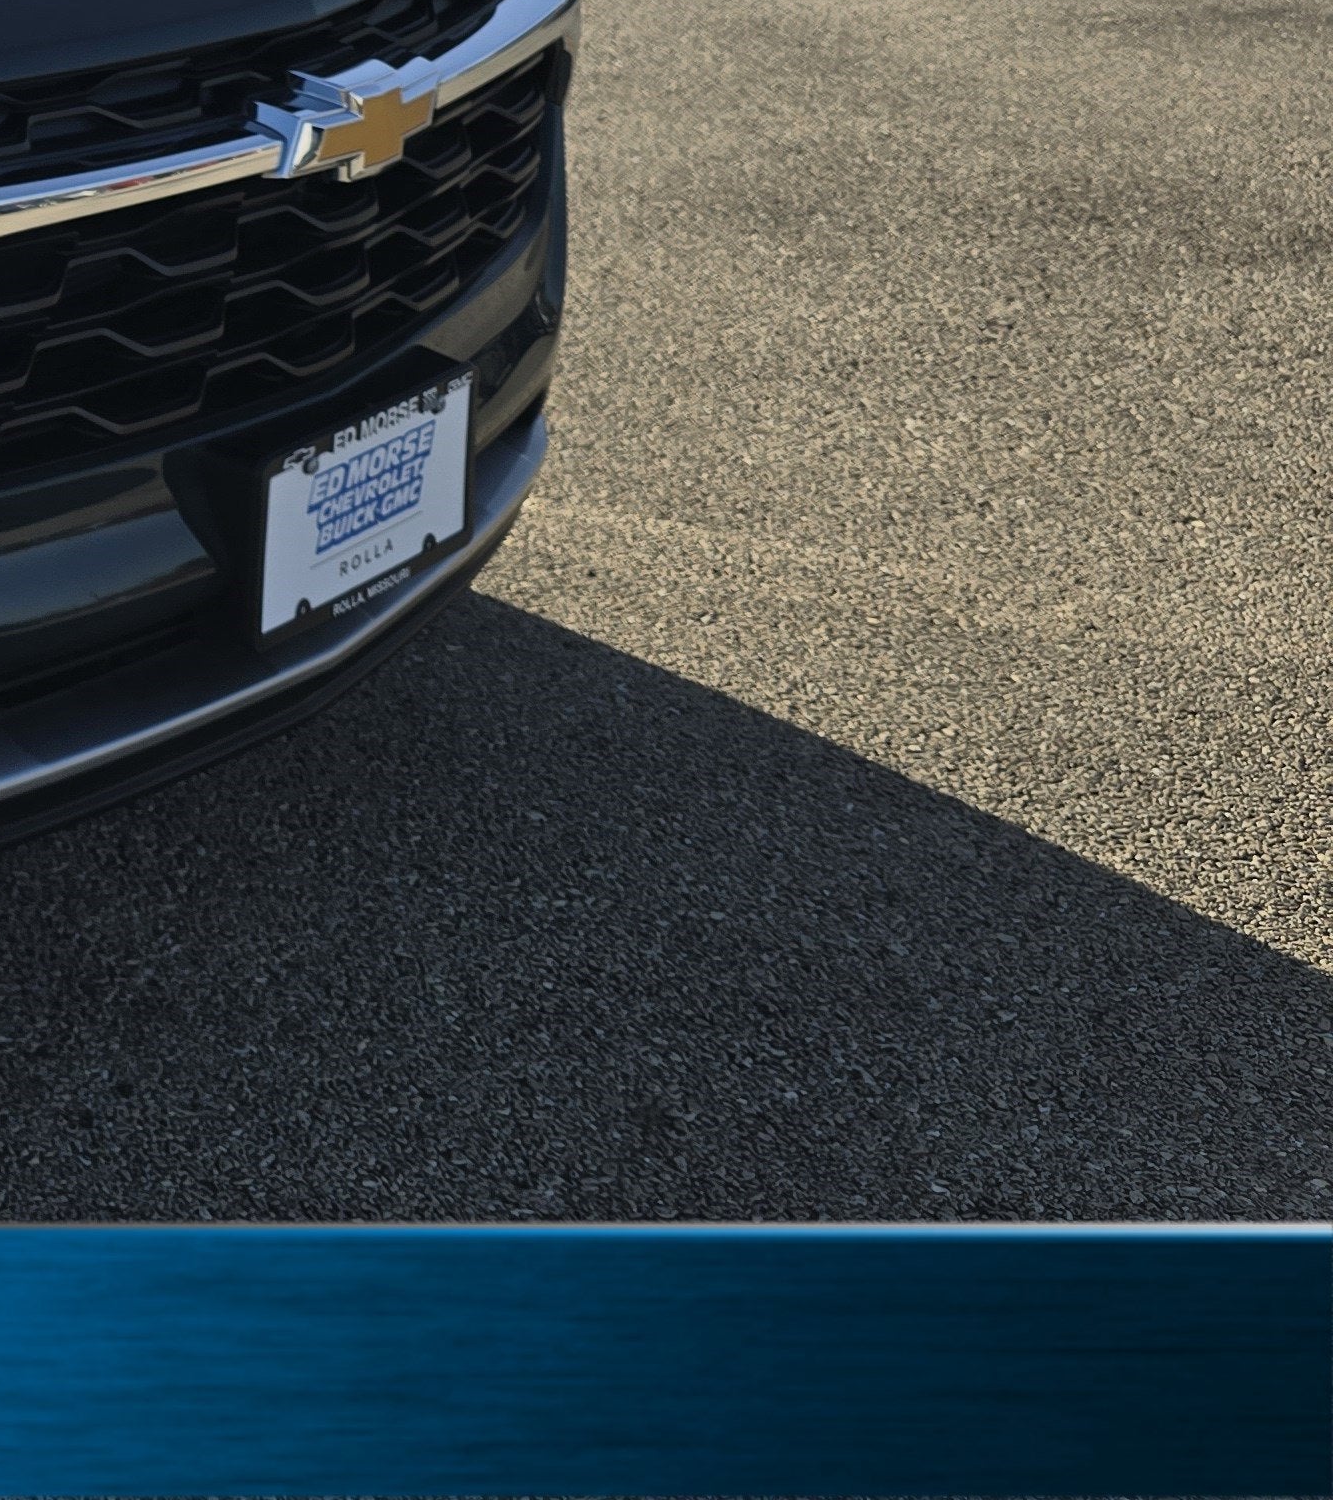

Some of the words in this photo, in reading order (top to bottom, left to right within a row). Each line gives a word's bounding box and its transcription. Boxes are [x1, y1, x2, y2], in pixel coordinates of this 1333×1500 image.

[333, 426, 357, 451] ED
[360, 395, 421, 440] MORSE
[310, 463, 347, 508] ED
[346, 421, 434, 489] MORSE
[318, 456, 425, 525] CHEVROLET
[317, 498, 378, 549] BUICK
[379, 478, 423, 518] GMC
[339, 538, 393, 576] ROLLA
